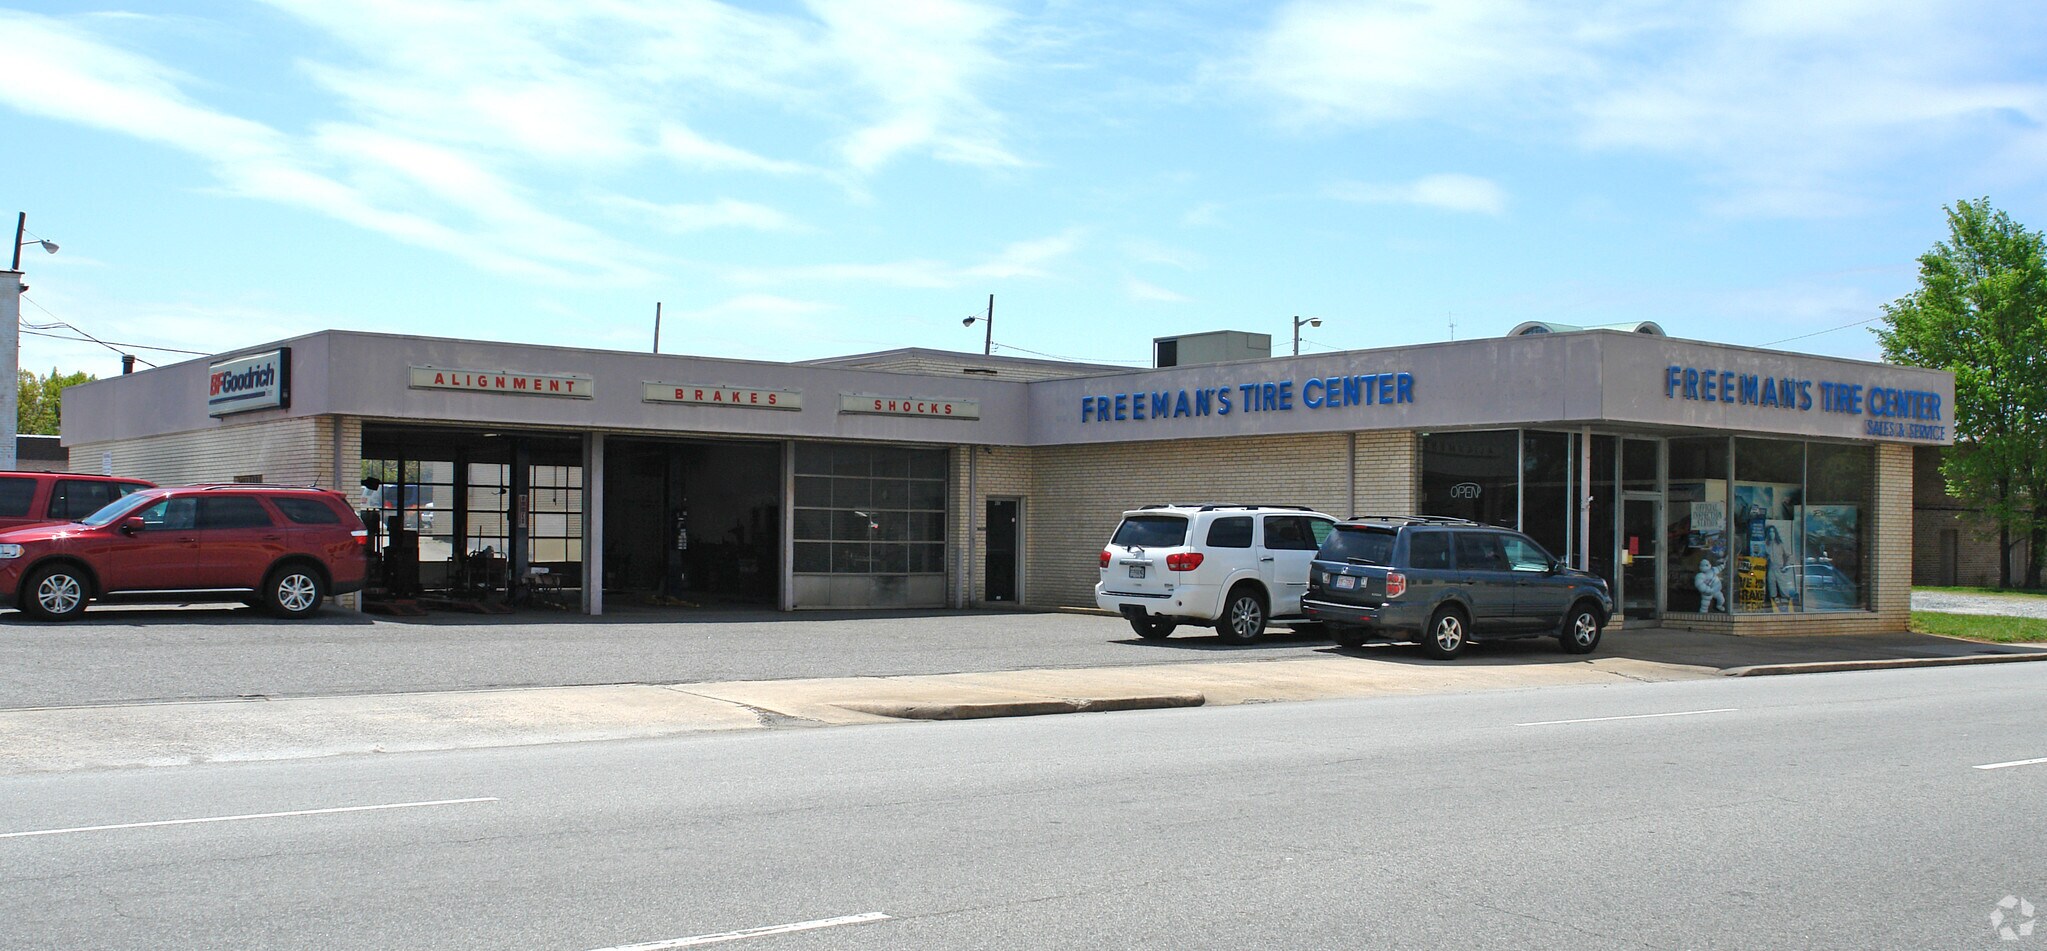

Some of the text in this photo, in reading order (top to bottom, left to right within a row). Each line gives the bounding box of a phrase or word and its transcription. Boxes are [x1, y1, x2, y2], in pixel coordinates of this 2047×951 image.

[209, 362, 275, 397] BFGoodrich
[434, 372, 575, 393] ALIGNMENT
[675, 388, 778, 405] BRAKES
[1081, 372, 1414, 423] FREEMAN'S TIRE CENTER
[1665, 365, 1942, 421] FREEMAN'S TIRE CENTER
[874, 399, 952, 415] SHOCKS
[1866, 420, 1945, 441] SALES & SERVICE
[1450, 484, 1480, 499] OPEN
